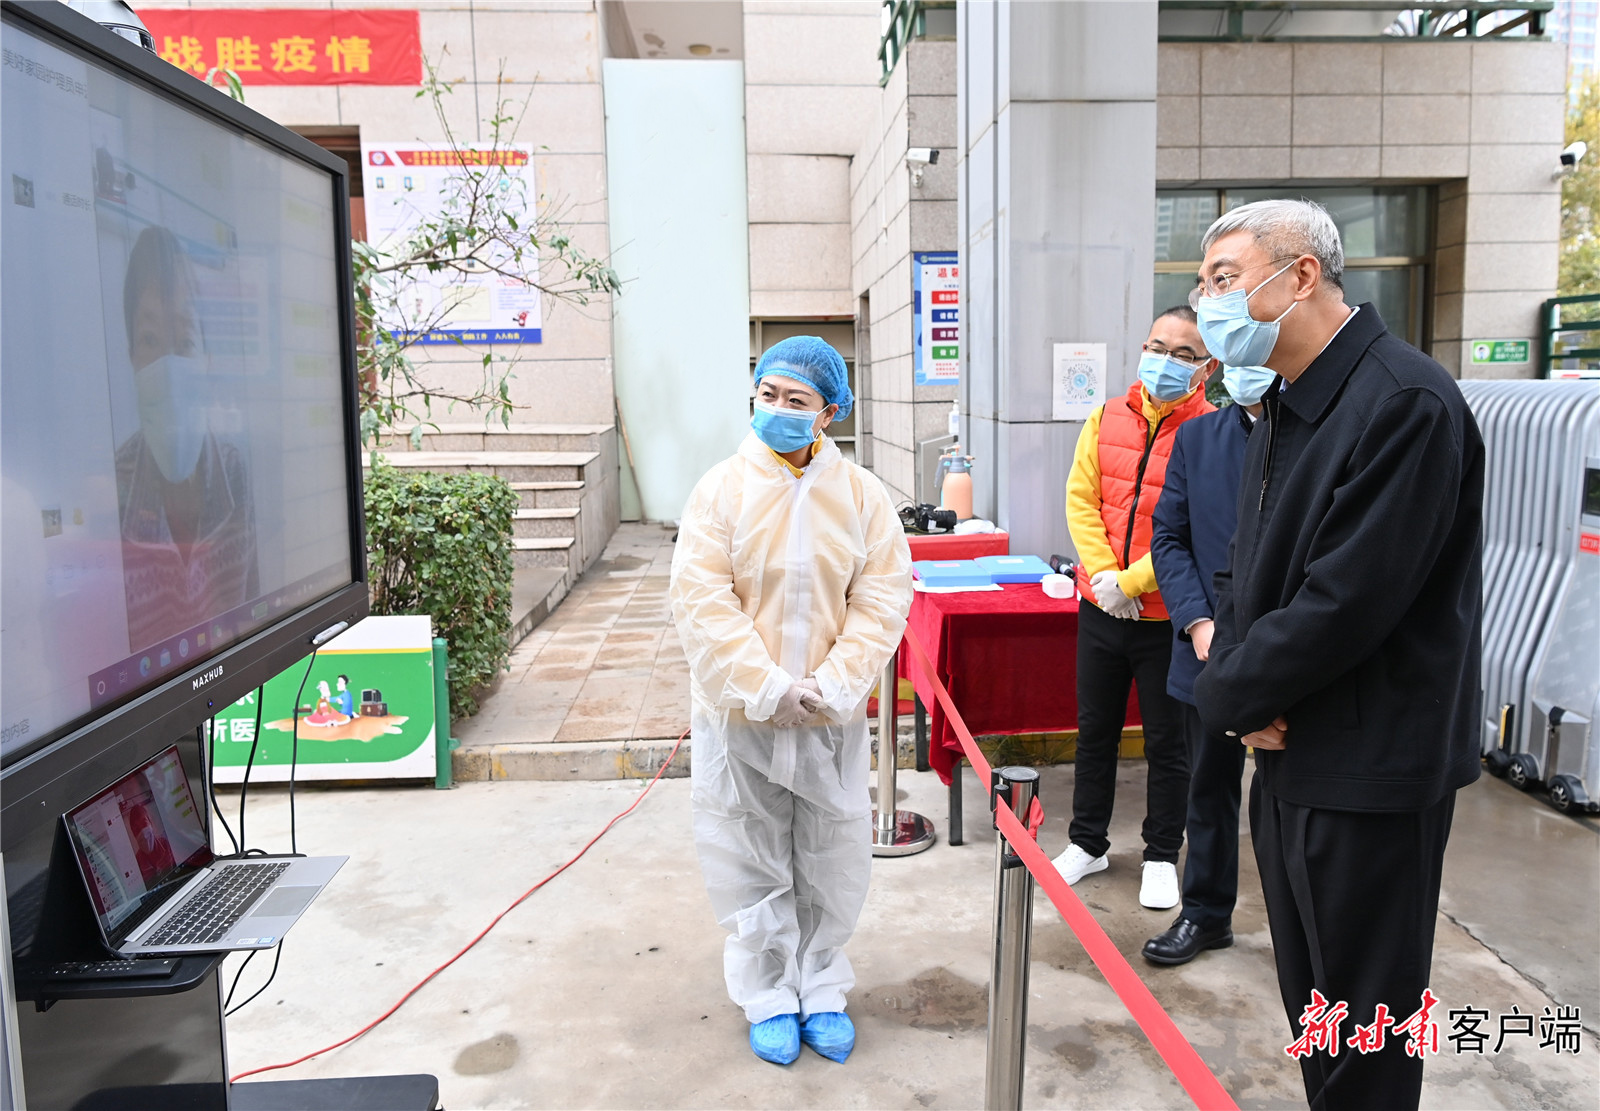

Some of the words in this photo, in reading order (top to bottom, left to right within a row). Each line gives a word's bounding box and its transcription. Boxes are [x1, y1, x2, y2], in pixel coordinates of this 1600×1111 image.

[160, 36, 373, 73] 战胜疫情
[192, 665, 224, 691] MAXHUB
